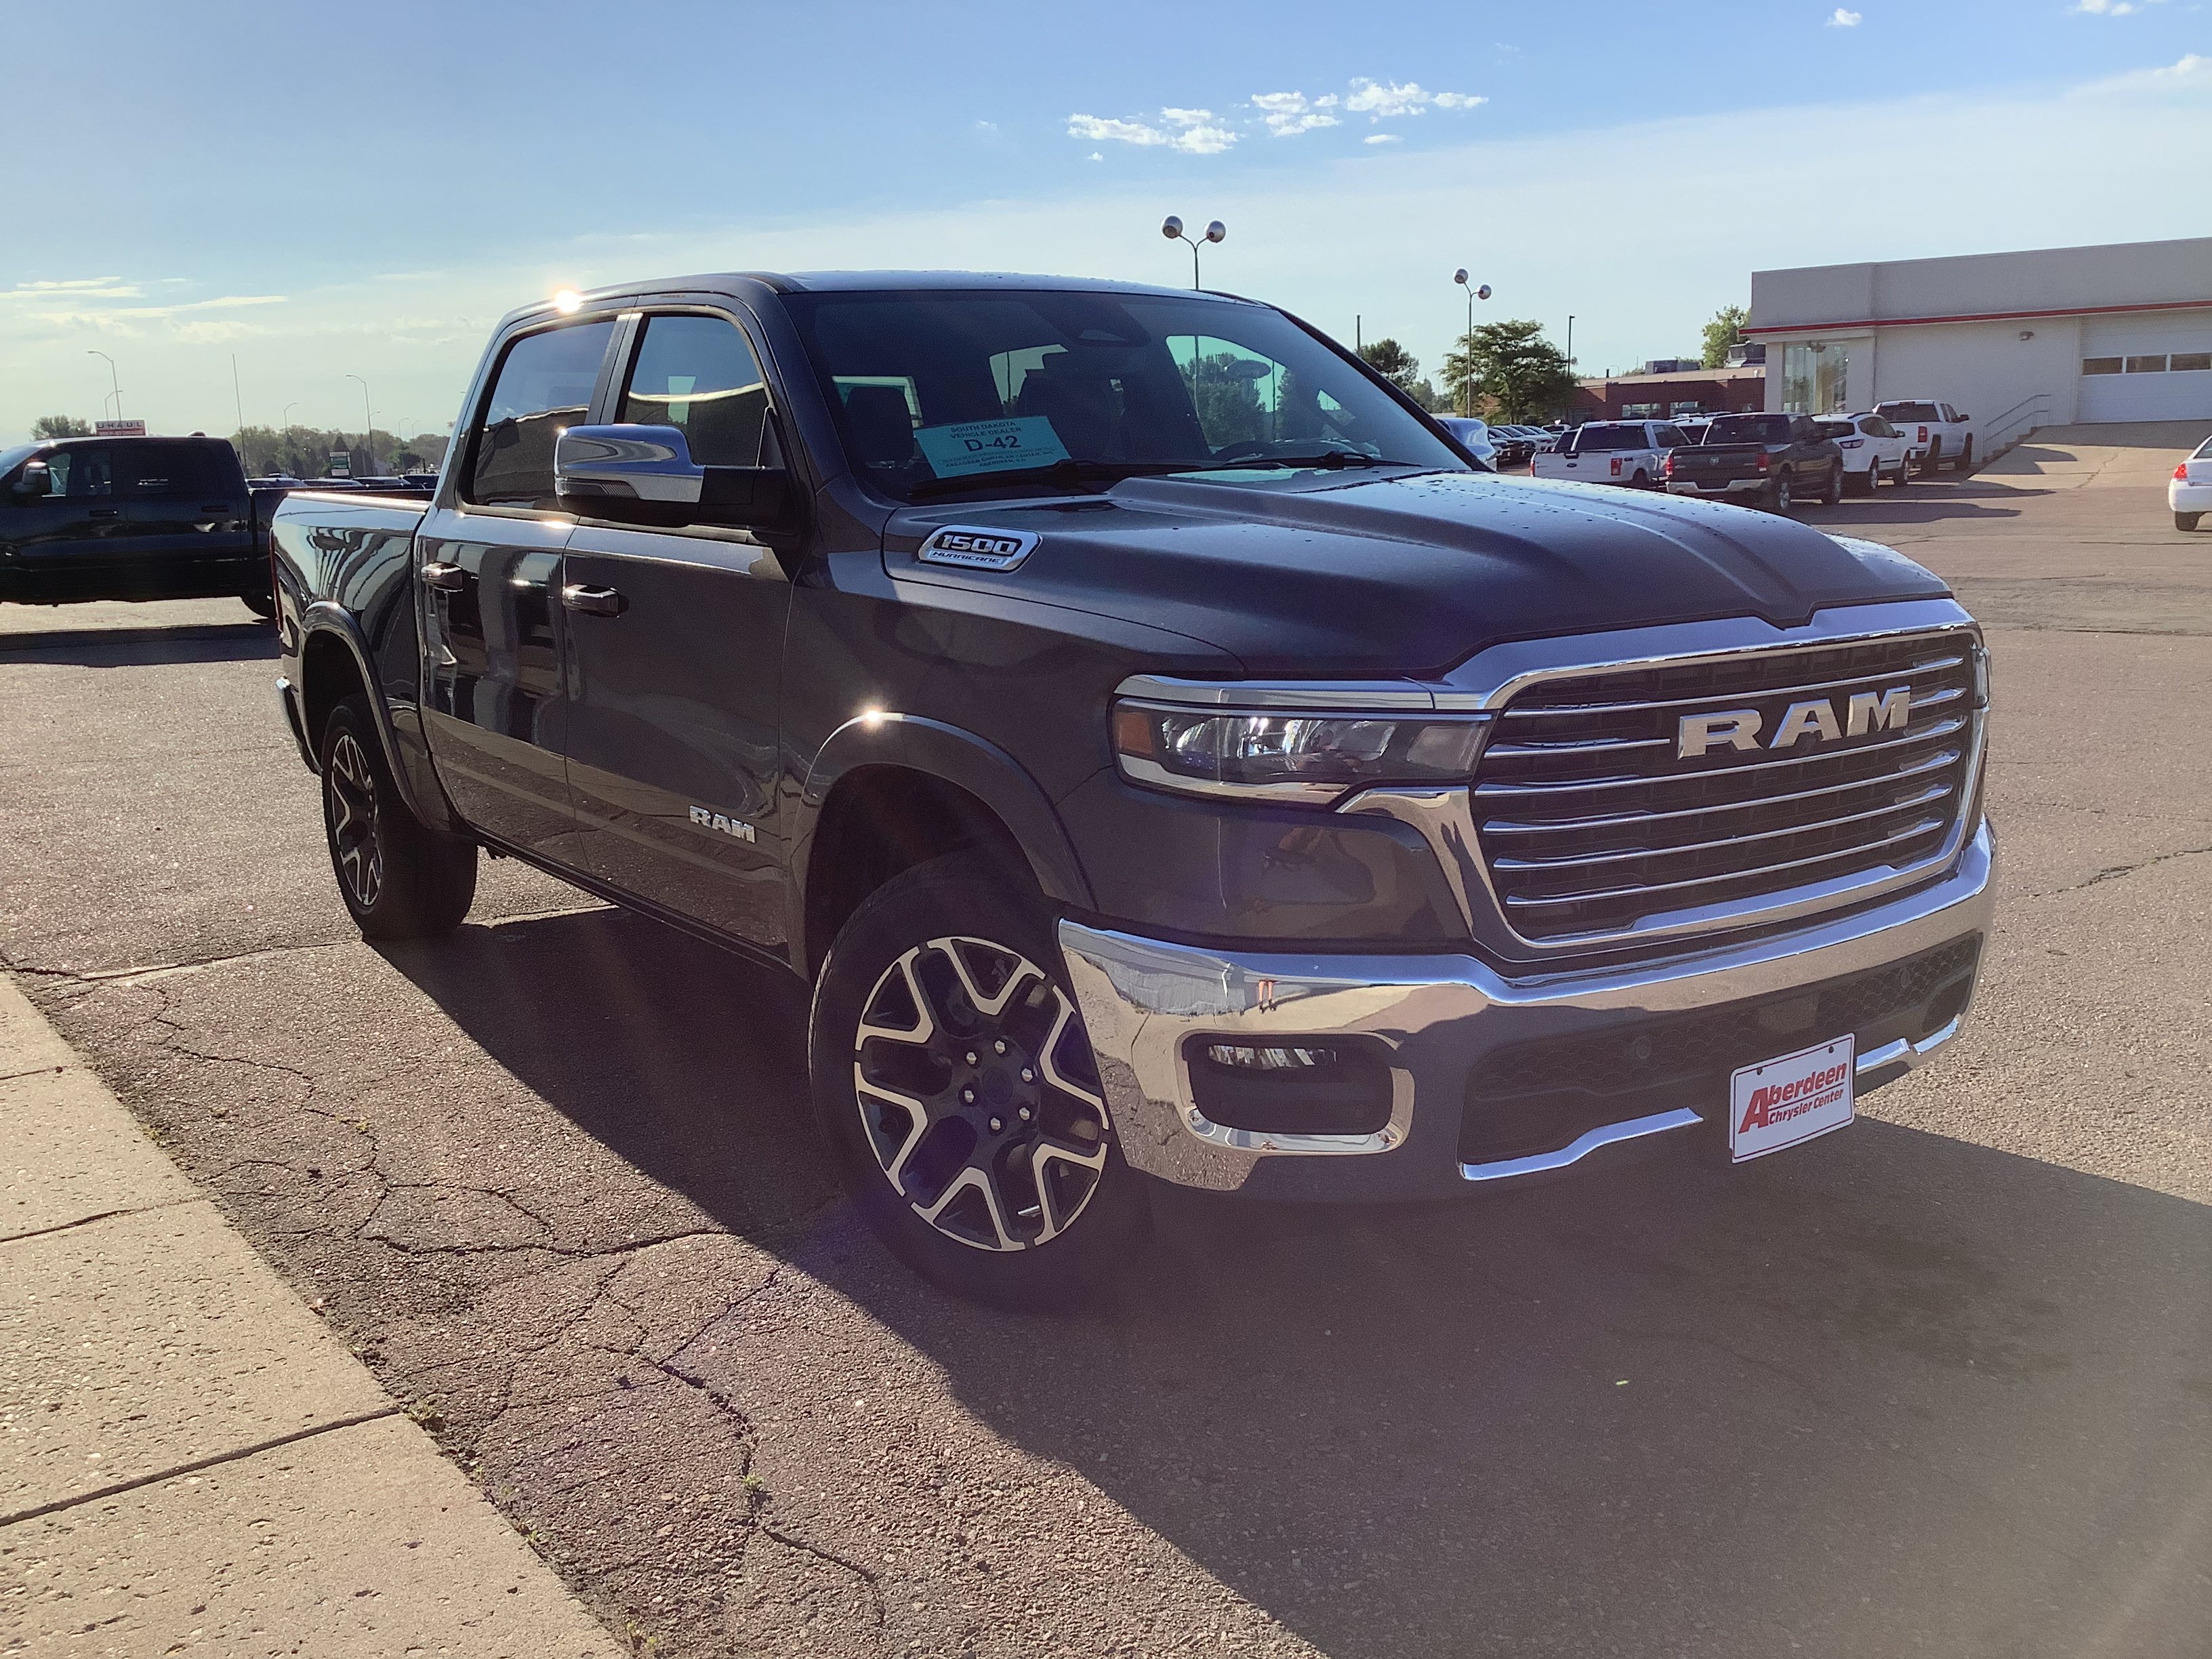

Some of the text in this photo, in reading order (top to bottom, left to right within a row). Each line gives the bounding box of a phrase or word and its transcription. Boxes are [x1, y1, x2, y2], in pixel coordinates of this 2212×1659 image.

[950, 426, 1022, 439] VEHICLE DEALER
[951, 421, 1016, 432] SOUTH DAKOTA
[964, 435, 1021, 452] D-42
[941, 534, 1018, 555] 1500
[932, 551, 1002, 563] HURRICANE
[1677, 685, 1911, 760] RAM
[689, 805, 756, 844] RAM
[1738, 1062, 1847, 1134] Aberdeen
[1769, 1088, 1844, 1124] Chrysler Center
